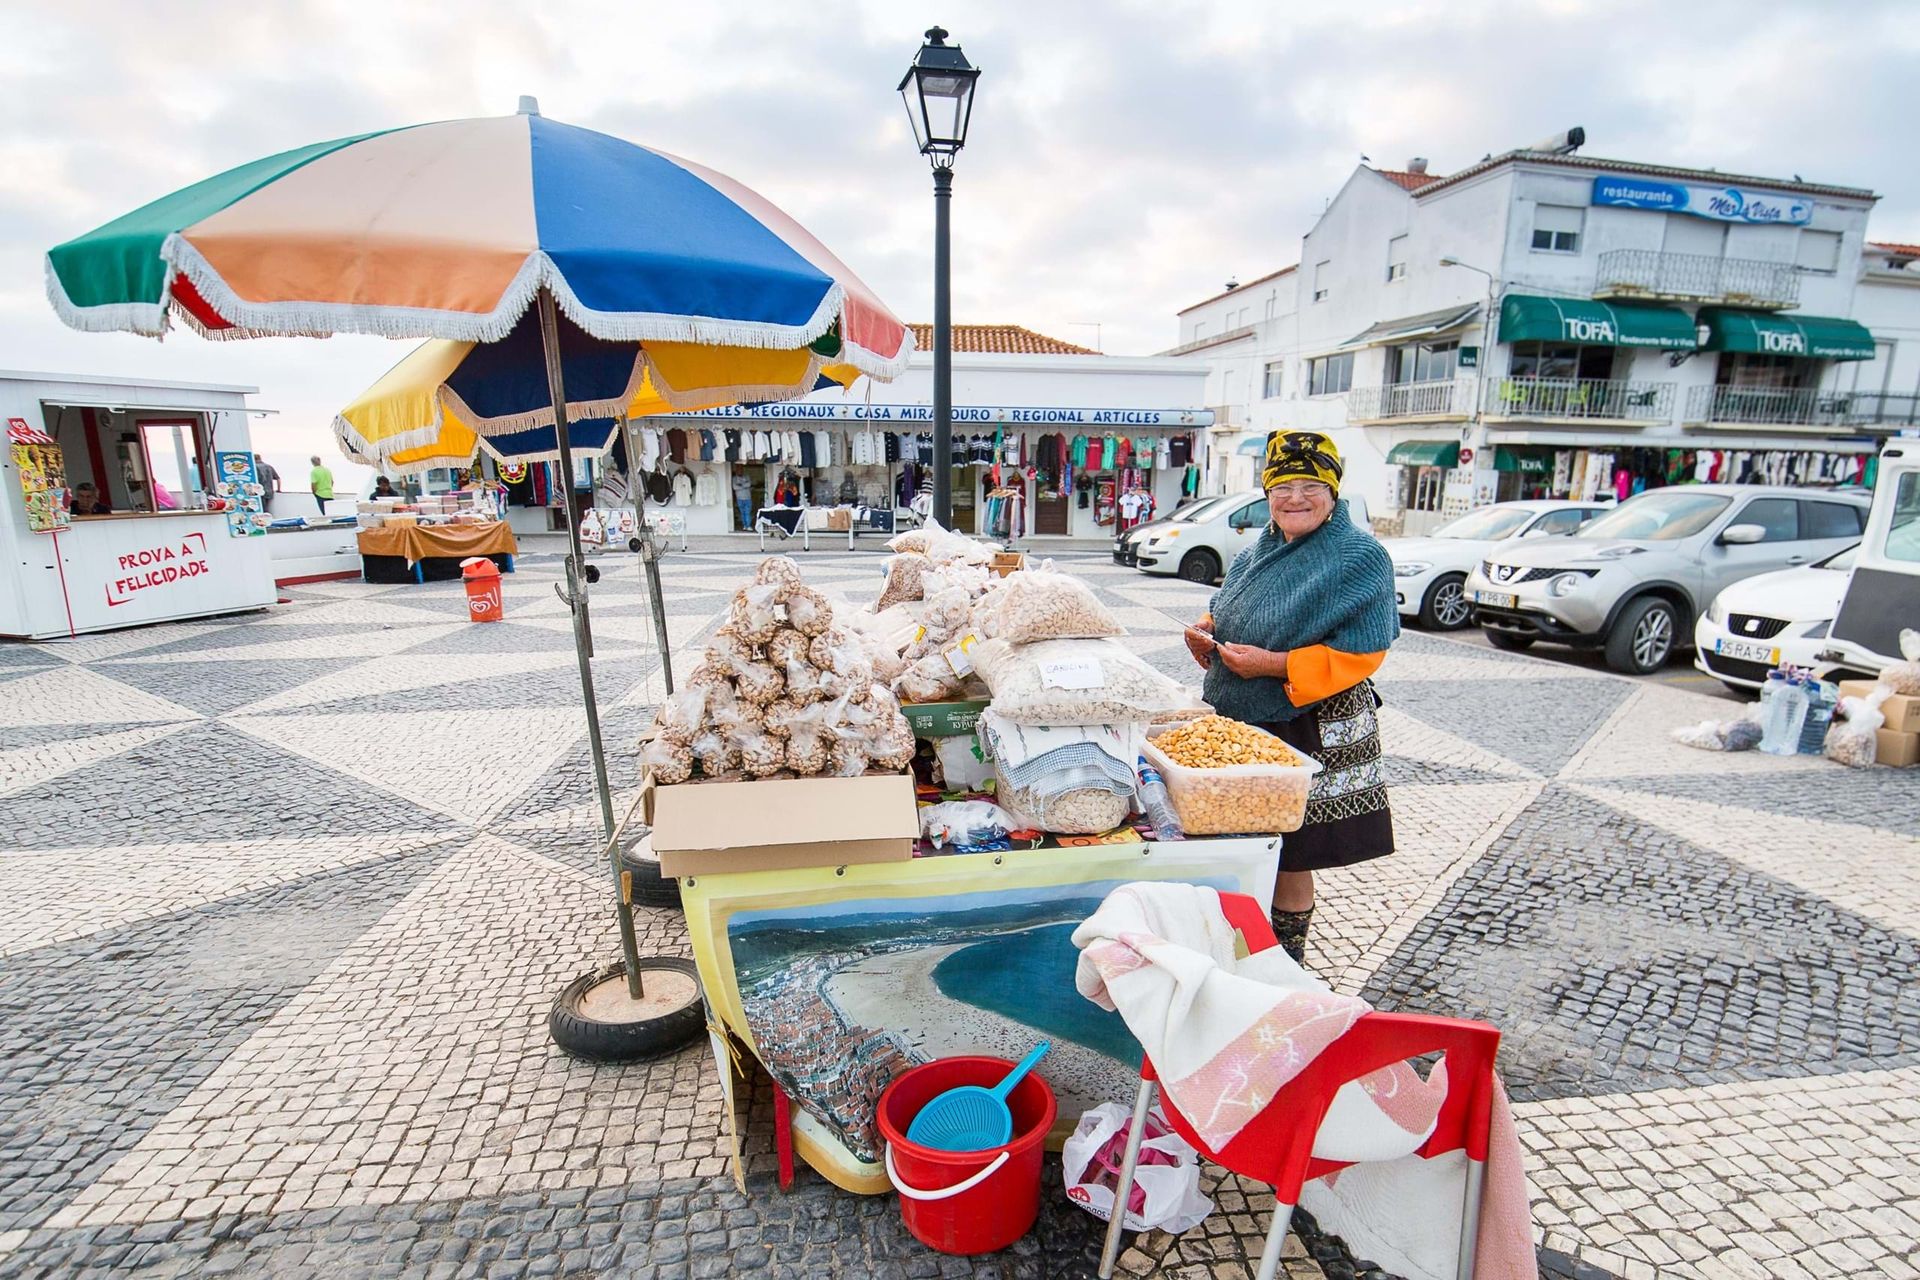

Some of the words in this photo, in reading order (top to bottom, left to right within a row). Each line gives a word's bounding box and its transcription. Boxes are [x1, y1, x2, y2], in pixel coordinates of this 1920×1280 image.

[1603, 185, 1674, 203] restaurante
[1709, 196, 1738, 216] Mar
[1751, 201, 1781, 220] Vista
[1565, 318, 1614, 341] TOFA
[1760, 330, 1804, 352] TOFA
[751, 405, 835, 417] REGIONAUX
[855, 407, 891, 419] CASA
[900, 407, 991, 421] MIRAOURO
[1012, 409, 1084, 422] REGIONAL
[1094, 411, 1160, 423] ARTICLES
[118, 547, 176, 570] PROVA
[182, 542, 193, 557] A
[115, 560, 209, 594] FELICIDADE
